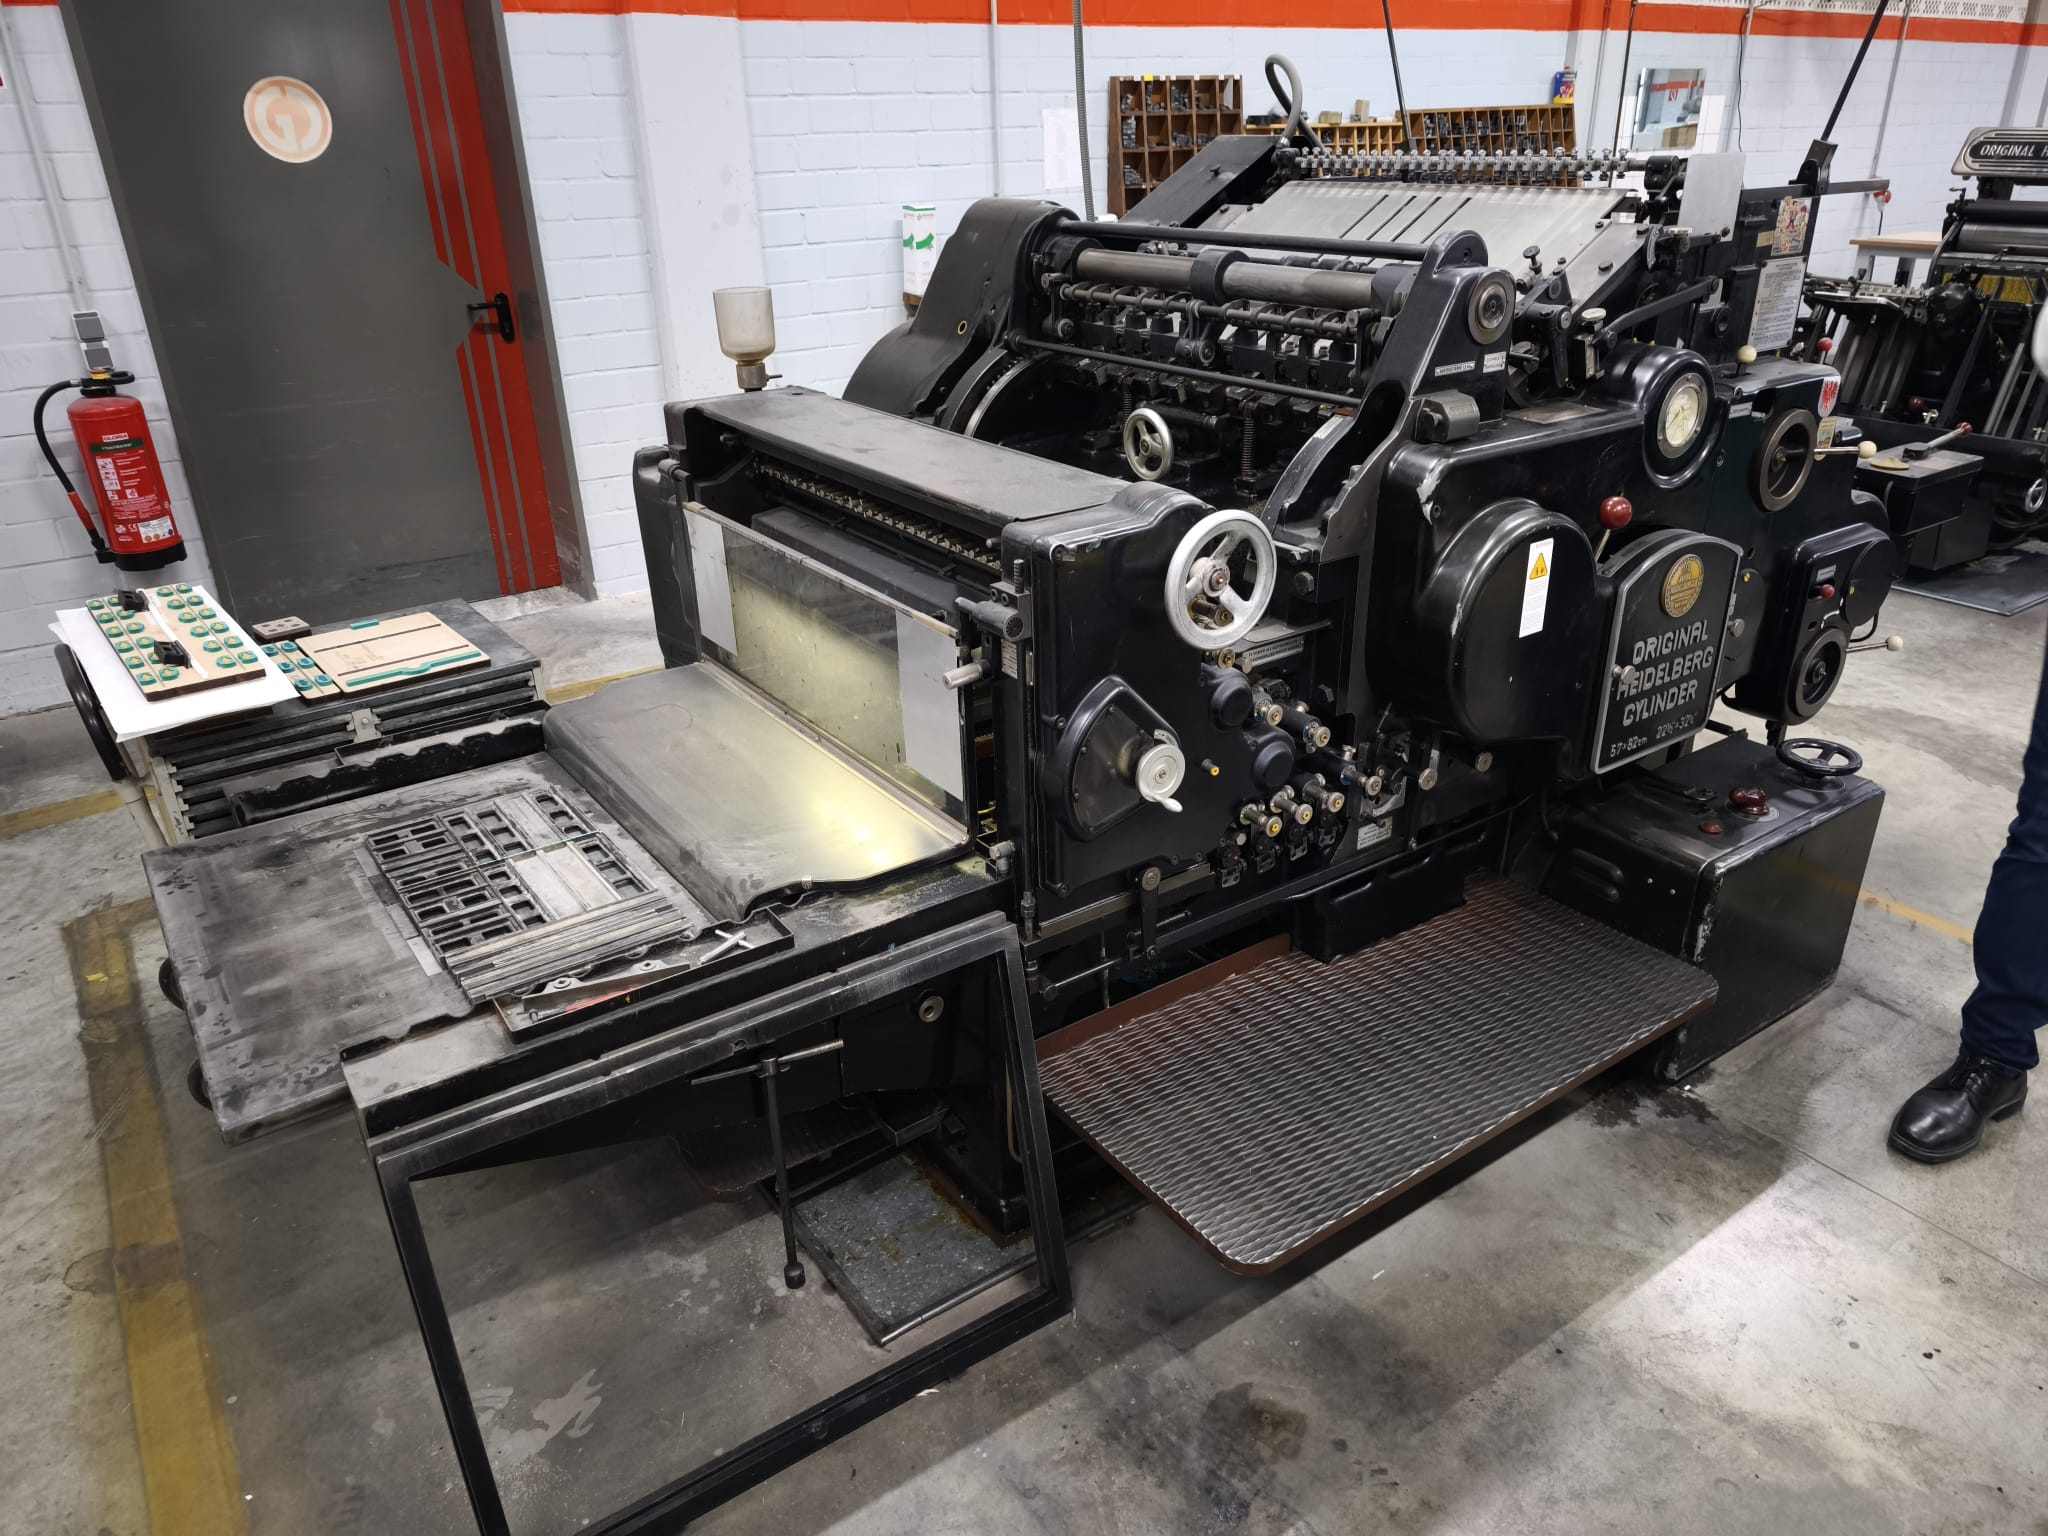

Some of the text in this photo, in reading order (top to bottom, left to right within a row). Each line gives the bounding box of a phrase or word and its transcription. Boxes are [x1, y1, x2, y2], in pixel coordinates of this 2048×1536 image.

[1980, 143, 2035, 157] ORIGINAL
[1633, 619, 1708, 665] ORIGINAL
[1616, 646, 1714, 701] HEIDELBERG
[1622, 679, 1698, 727] CYLINDER
